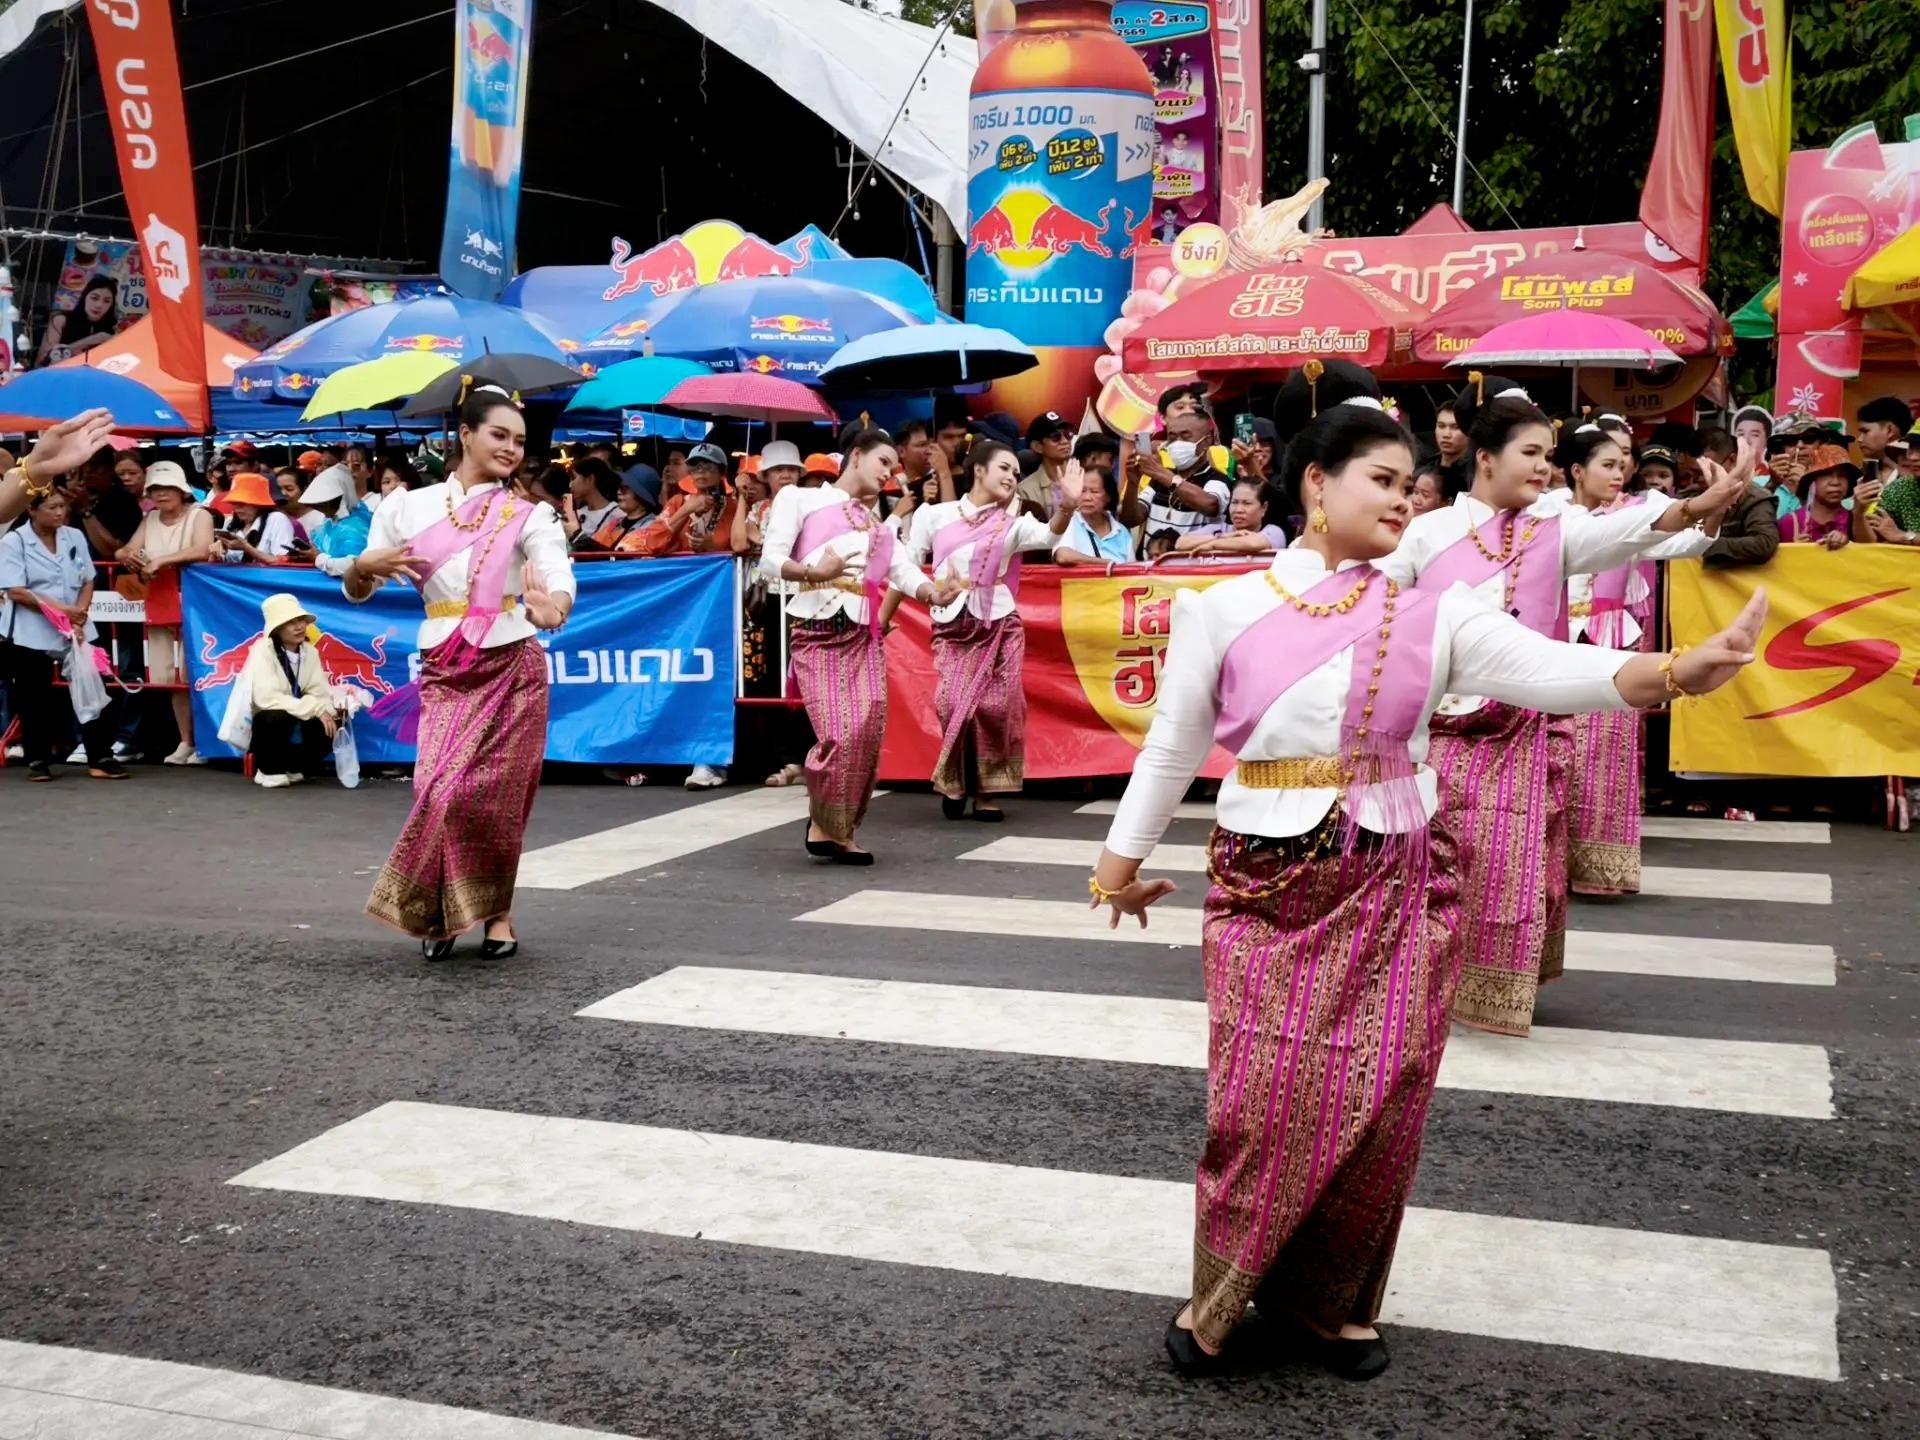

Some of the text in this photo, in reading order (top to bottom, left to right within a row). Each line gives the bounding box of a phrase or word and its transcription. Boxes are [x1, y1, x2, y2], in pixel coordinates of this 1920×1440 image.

[1150, 9, 1166, 26] 2
[1117, 28, 1146, 36] 2569
[972, 105, 1097, 130] ทอรีน 1000 มก.
[1809, 225, 1865, 248] เกลือแร่
[1181, 239, 1220, 262] ซิงค์
[968, 280, 1103, 304] กระทิงแดง
[1501, 271, 1634, 297] โสมพลัส
[1522, 297, 1604, 310] Som Plus
[1148, 334, 1265, 360] โสมเกาหลีสกัด
